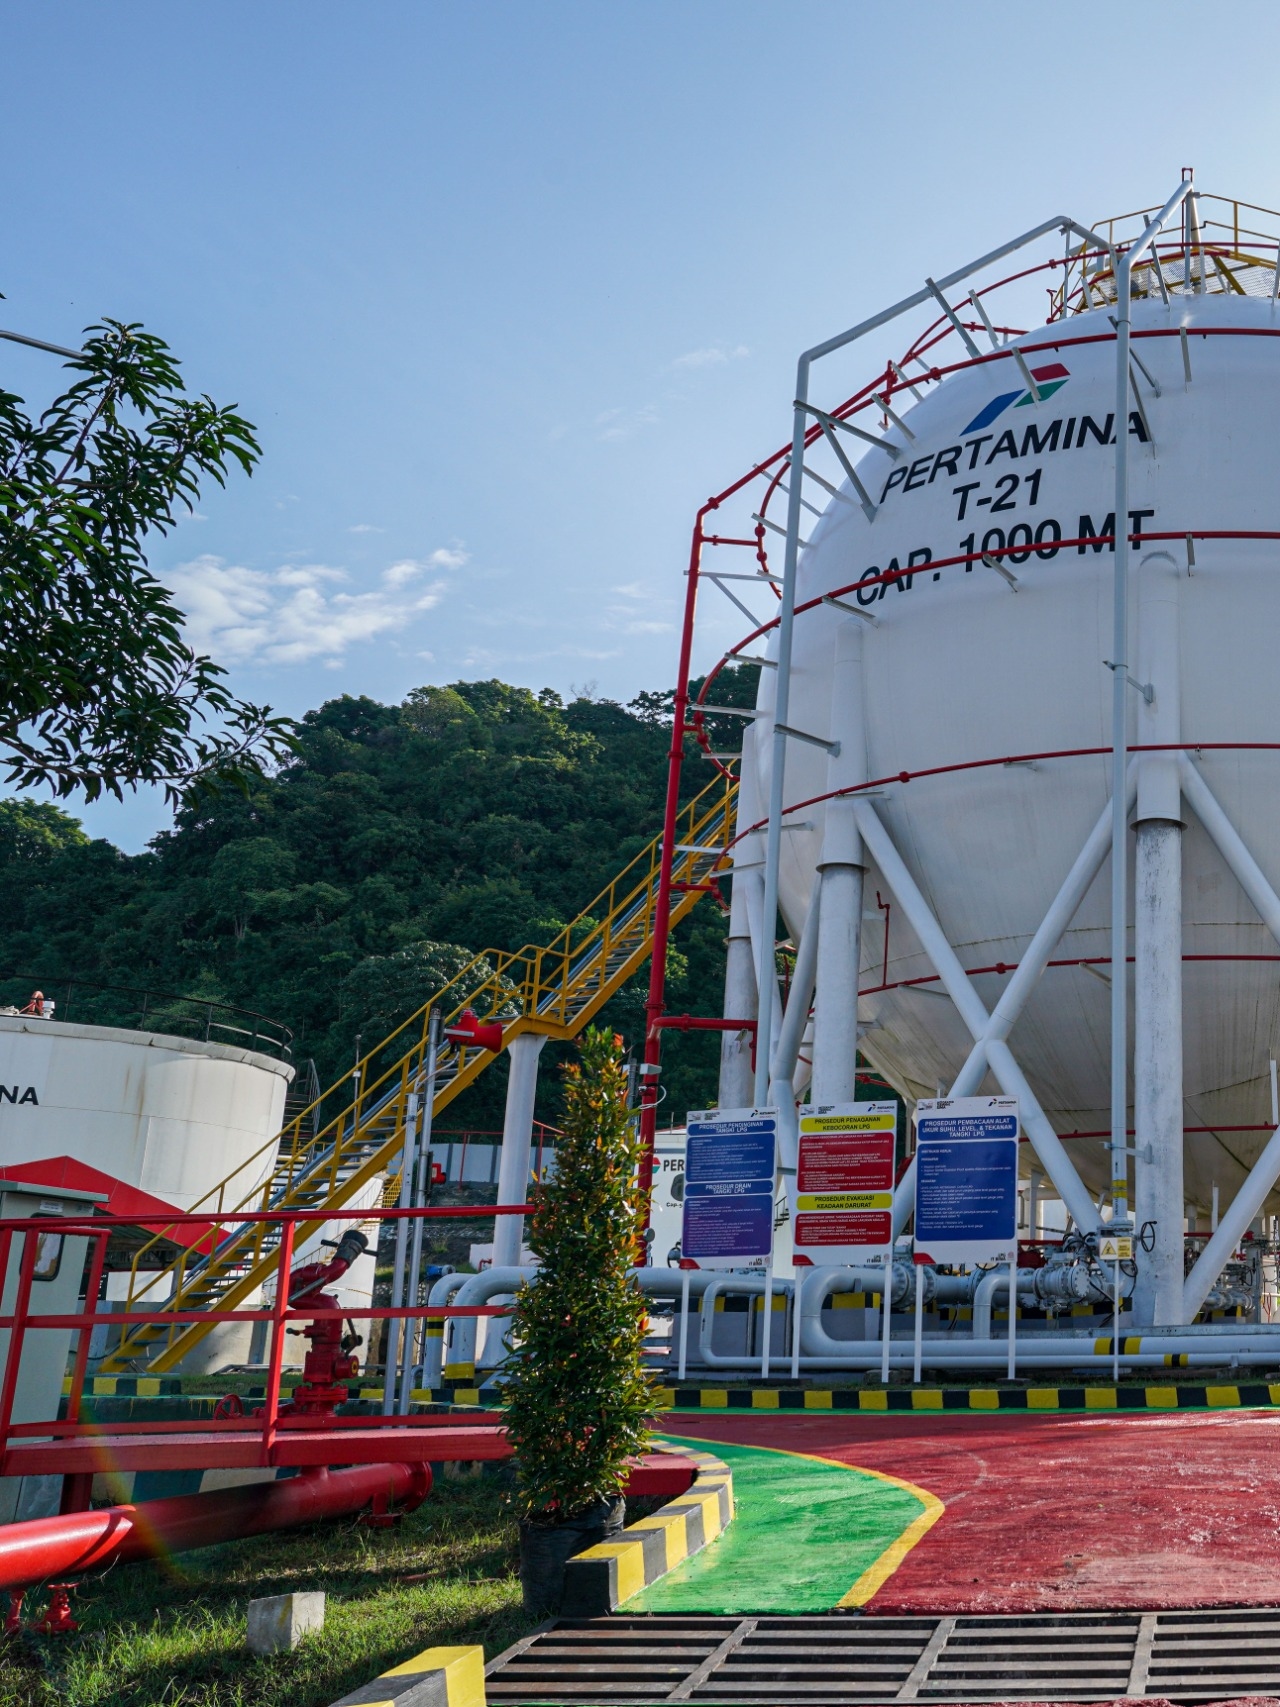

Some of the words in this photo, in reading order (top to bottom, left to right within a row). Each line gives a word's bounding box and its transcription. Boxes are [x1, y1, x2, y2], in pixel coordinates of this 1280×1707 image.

[879, 411, 1150, 504] PERTAMINA
[952, 468, 1043, 521] T-21
[856, 547, 940, 606] CAP.
[960, 519, 1062, 573] 1000
[1078, 509, 1154, 555] MT
